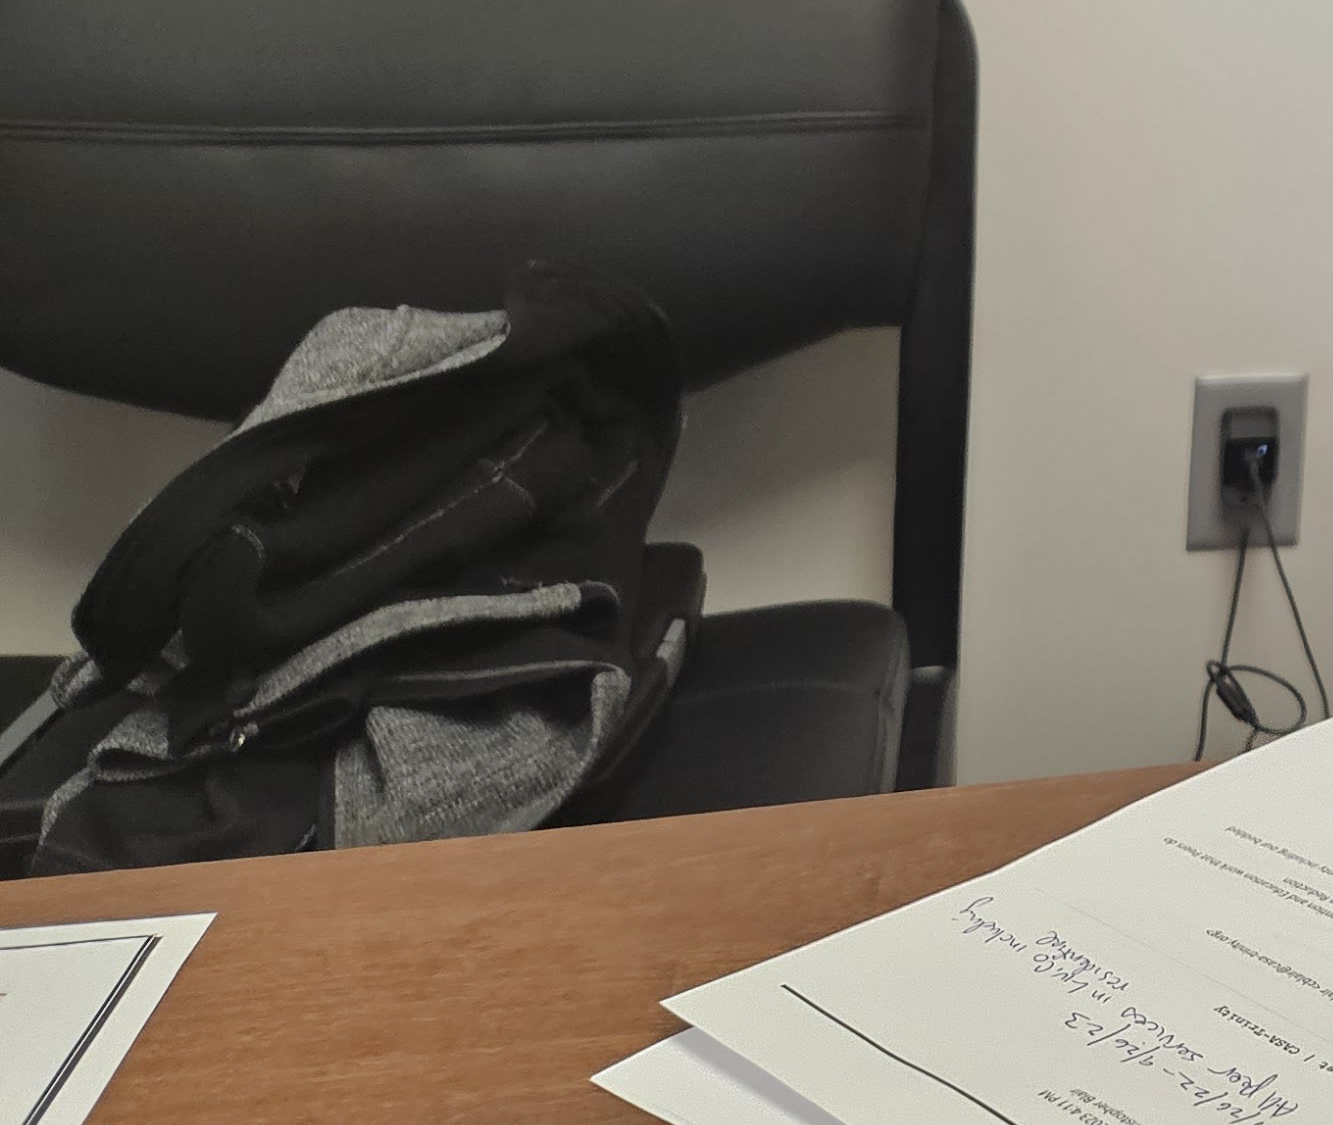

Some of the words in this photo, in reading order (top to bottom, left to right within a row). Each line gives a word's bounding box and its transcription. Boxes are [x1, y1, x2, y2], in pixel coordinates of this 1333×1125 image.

[1199, 853, 1223, 867] that
[1219, 862, 1245, 876] work
[1242, 872, 1291, 899] Education
[1284, 893, 1310, 906] and
[951, 896, 1029, 953] including
[1205, 929, 1322, 990] <cblair@casa-trinity.org>
[1090, 989, 1112, 1004] in
[1119, 1005, 1205, 1062] services
[1212, 1004, 1301, 1055] CASA-Trinity
[1206, 1066, 1279, 1099] peer
[1254, 1090, 1300, 1119] All
